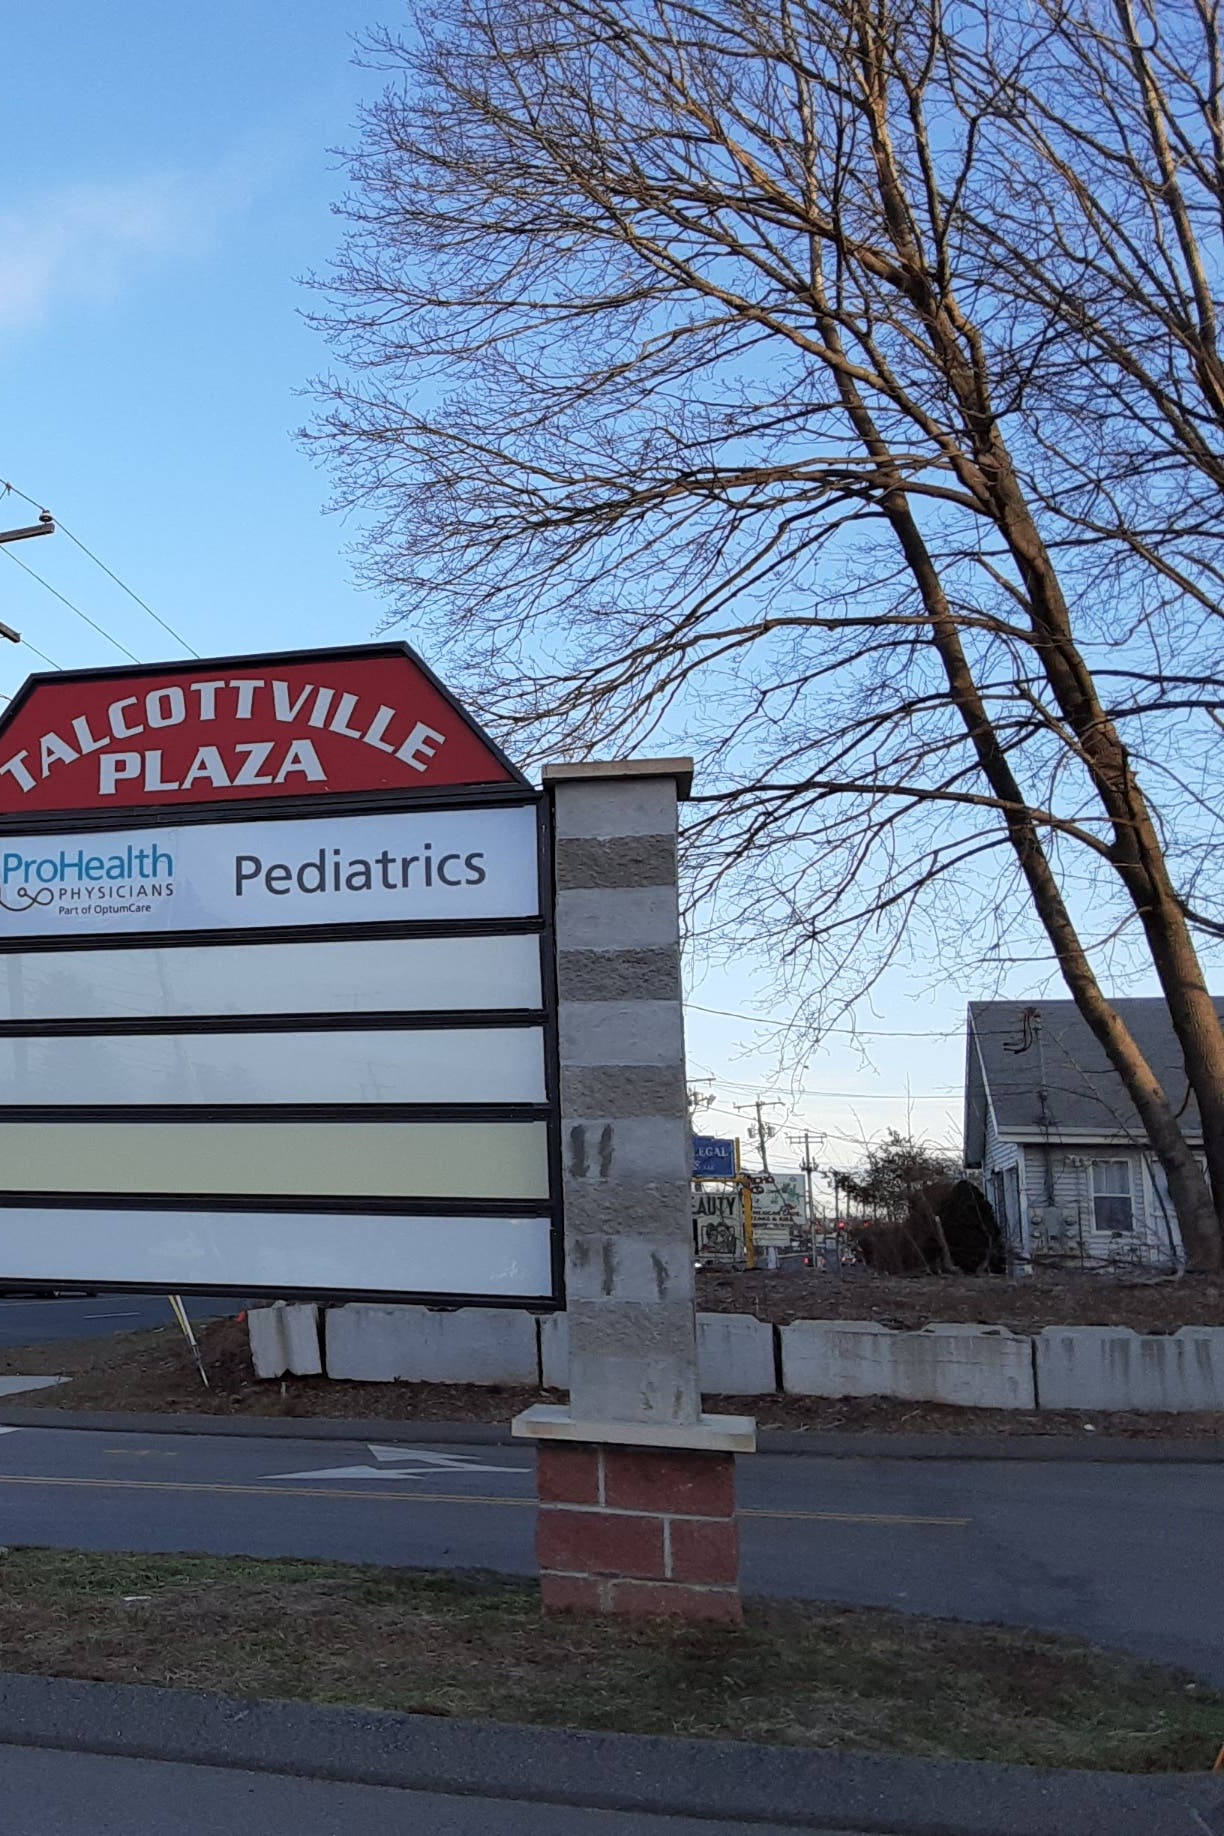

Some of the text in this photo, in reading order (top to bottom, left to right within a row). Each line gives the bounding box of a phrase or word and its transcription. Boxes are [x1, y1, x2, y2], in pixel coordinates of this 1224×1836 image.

[98, 739, 328, 795] PLAZA
[2, 843, 174, 885] ProHealth
[235, 843, 487, 897] Pediatrics
[58, 903, 152, 917] Part of OptumCare
[59, 882, 174, 901] PHYSICIANS
